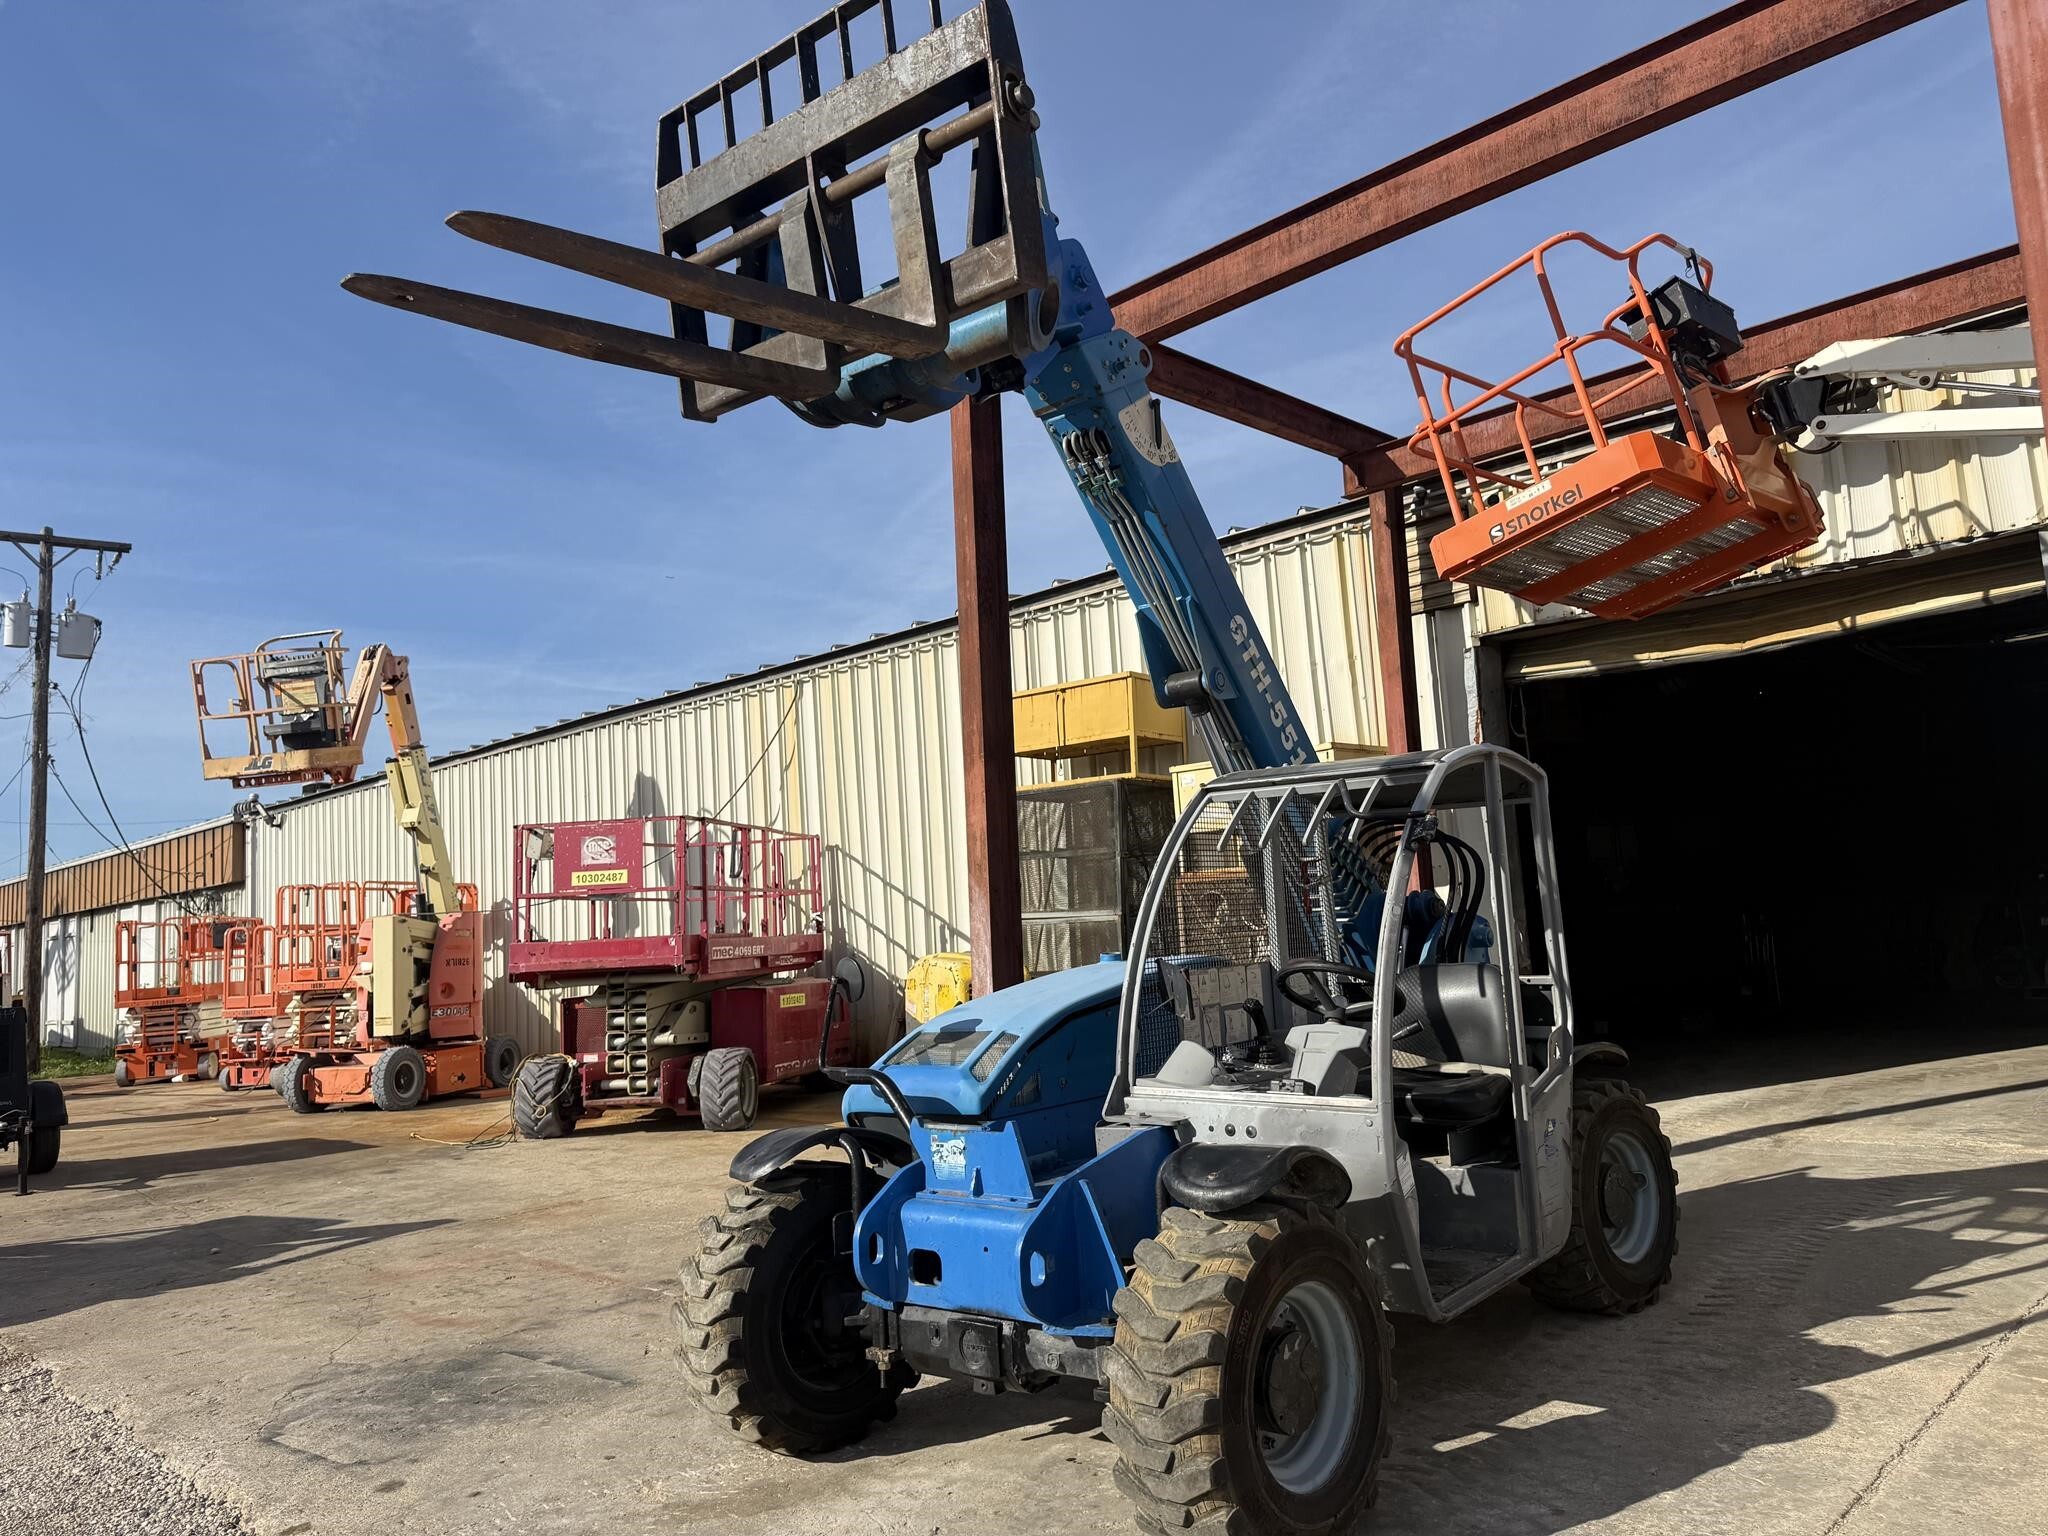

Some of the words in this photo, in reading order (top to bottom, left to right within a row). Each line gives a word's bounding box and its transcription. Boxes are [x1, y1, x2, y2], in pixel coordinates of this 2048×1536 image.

[1506, 484, 1583, 535] snorkel
[244, 756, 272, 771] JLG
[576, 872, 624, 884] 10302487
[712, 946, 733, 959] mec
[752, 945, 765, 955] ERT
